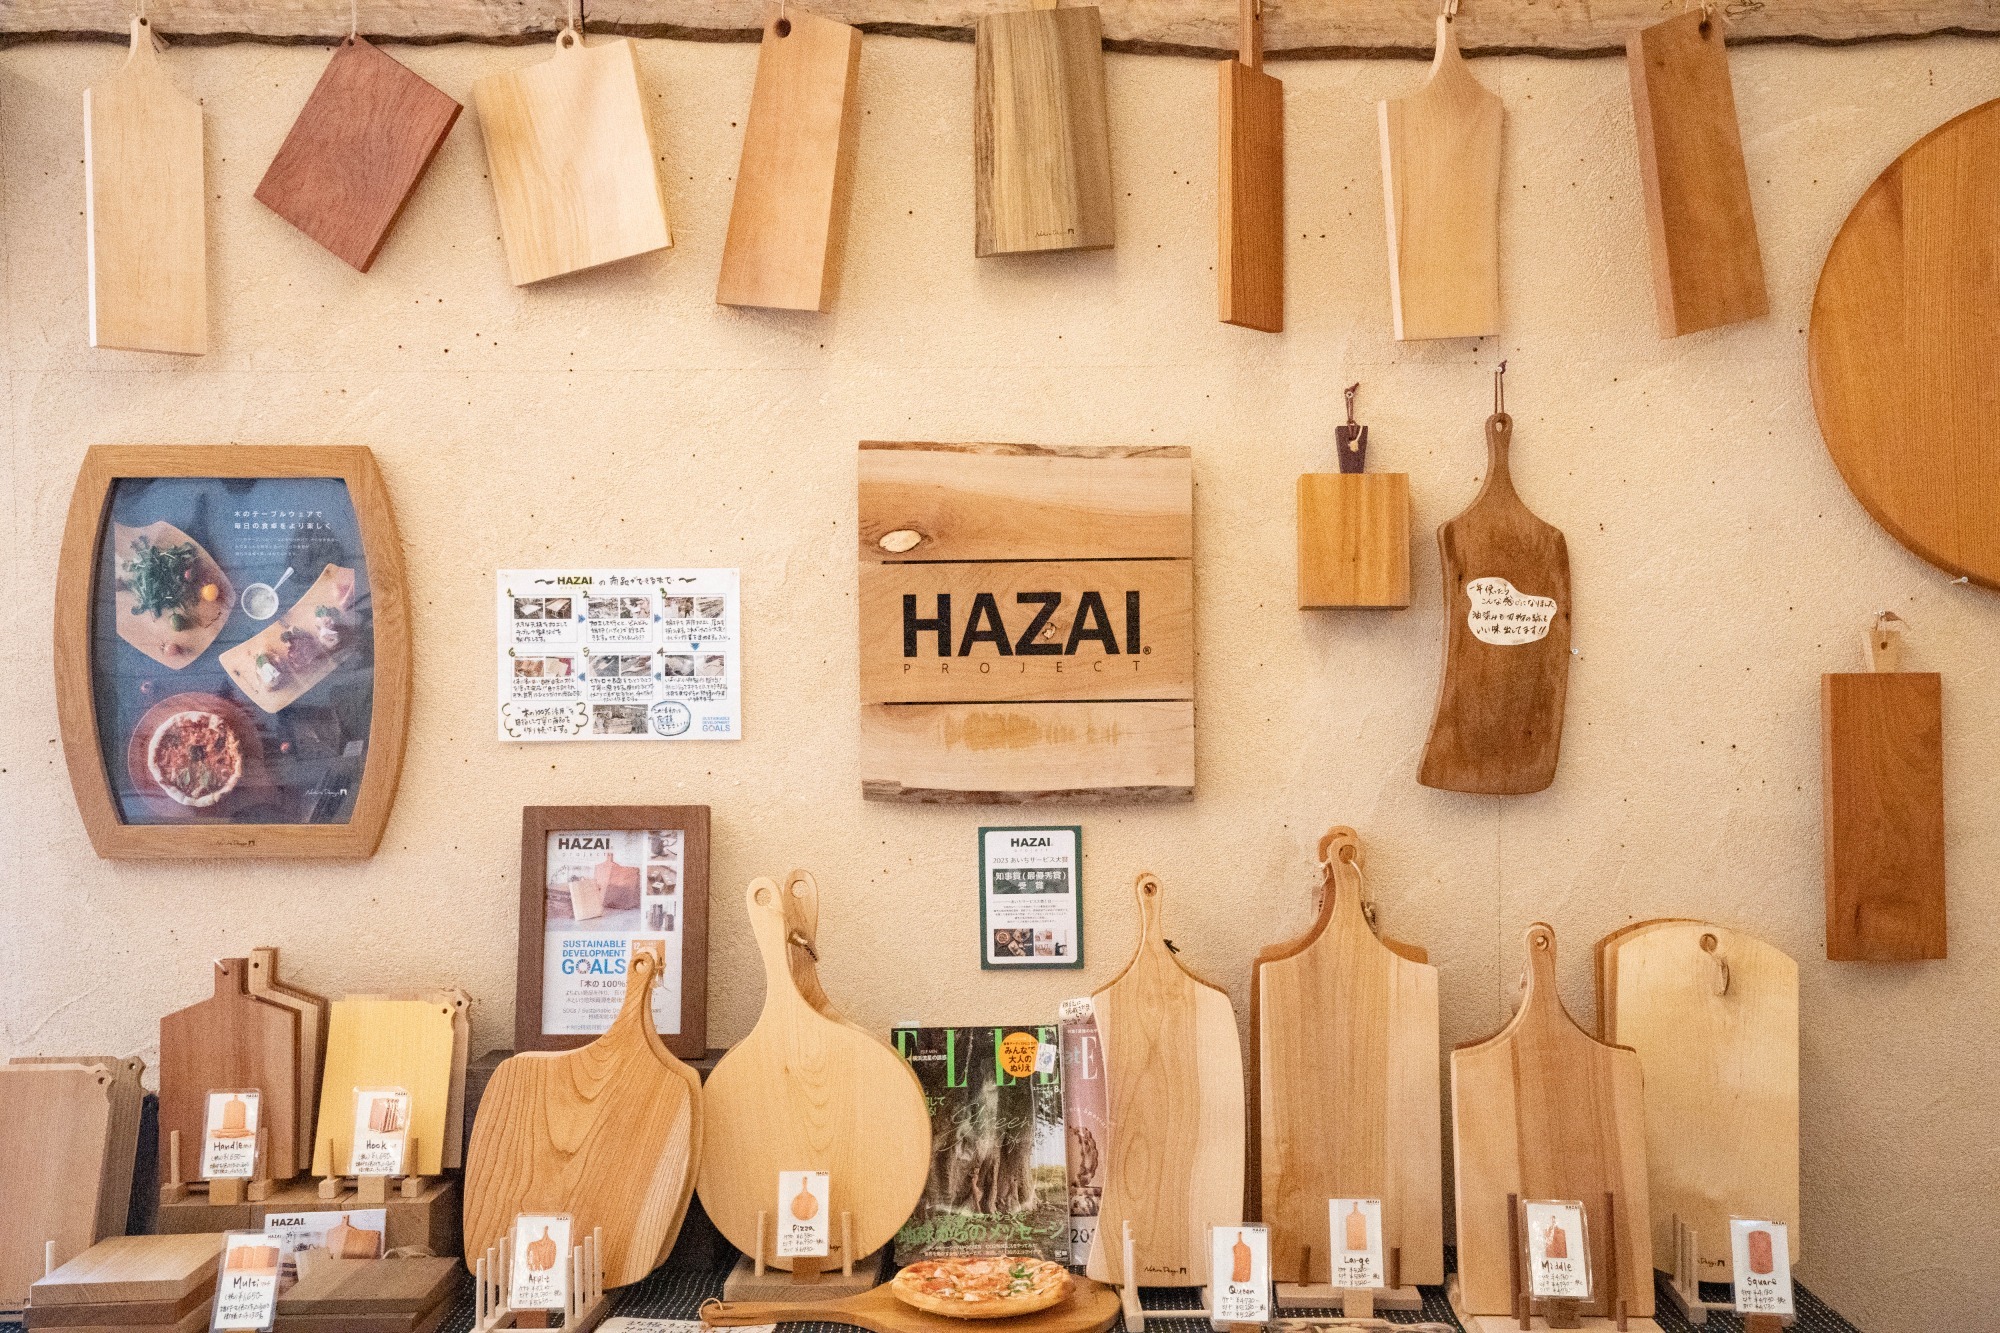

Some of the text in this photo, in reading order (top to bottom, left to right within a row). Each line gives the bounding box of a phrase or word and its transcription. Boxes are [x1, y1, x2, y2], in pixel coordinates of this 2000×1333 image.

[234, 522, 331, 530] 毎日の食卓をより楽しく
[557, 577, 592, 585] HAZAI
[508, 647, 516, 657] 6
[657, 647, 665, 656] 4
[903, 660, 1141, 674] PROJECT
[558, 837, 610, 850] HAZAI
[1010, 837, 1051, 848] HAZAI
[562, 940, 626, 948] SUSTAINABLE
[561, 958, 626, 975] GOALS
[1004, 1046, 1036, 1054] みんなで
[1008, 1055, 1032, 1064] 大人の
[1010, 1063, 1032, 1072] ぬりえ
[366, 1140, 387, 1150] Hook
[271, 1218, 304, 1227] HAZAI
[792, 1224, 815, 1233] Pizza
[1344, 1256, 1370, 1269] Large
[1542, 1260, 1572, 1272] Middle
[233, 1276, 260, 1290] Multi
[1747, 1277, 1777, 1288] Square
[1229, 1285, 1255, 1295] Queen
